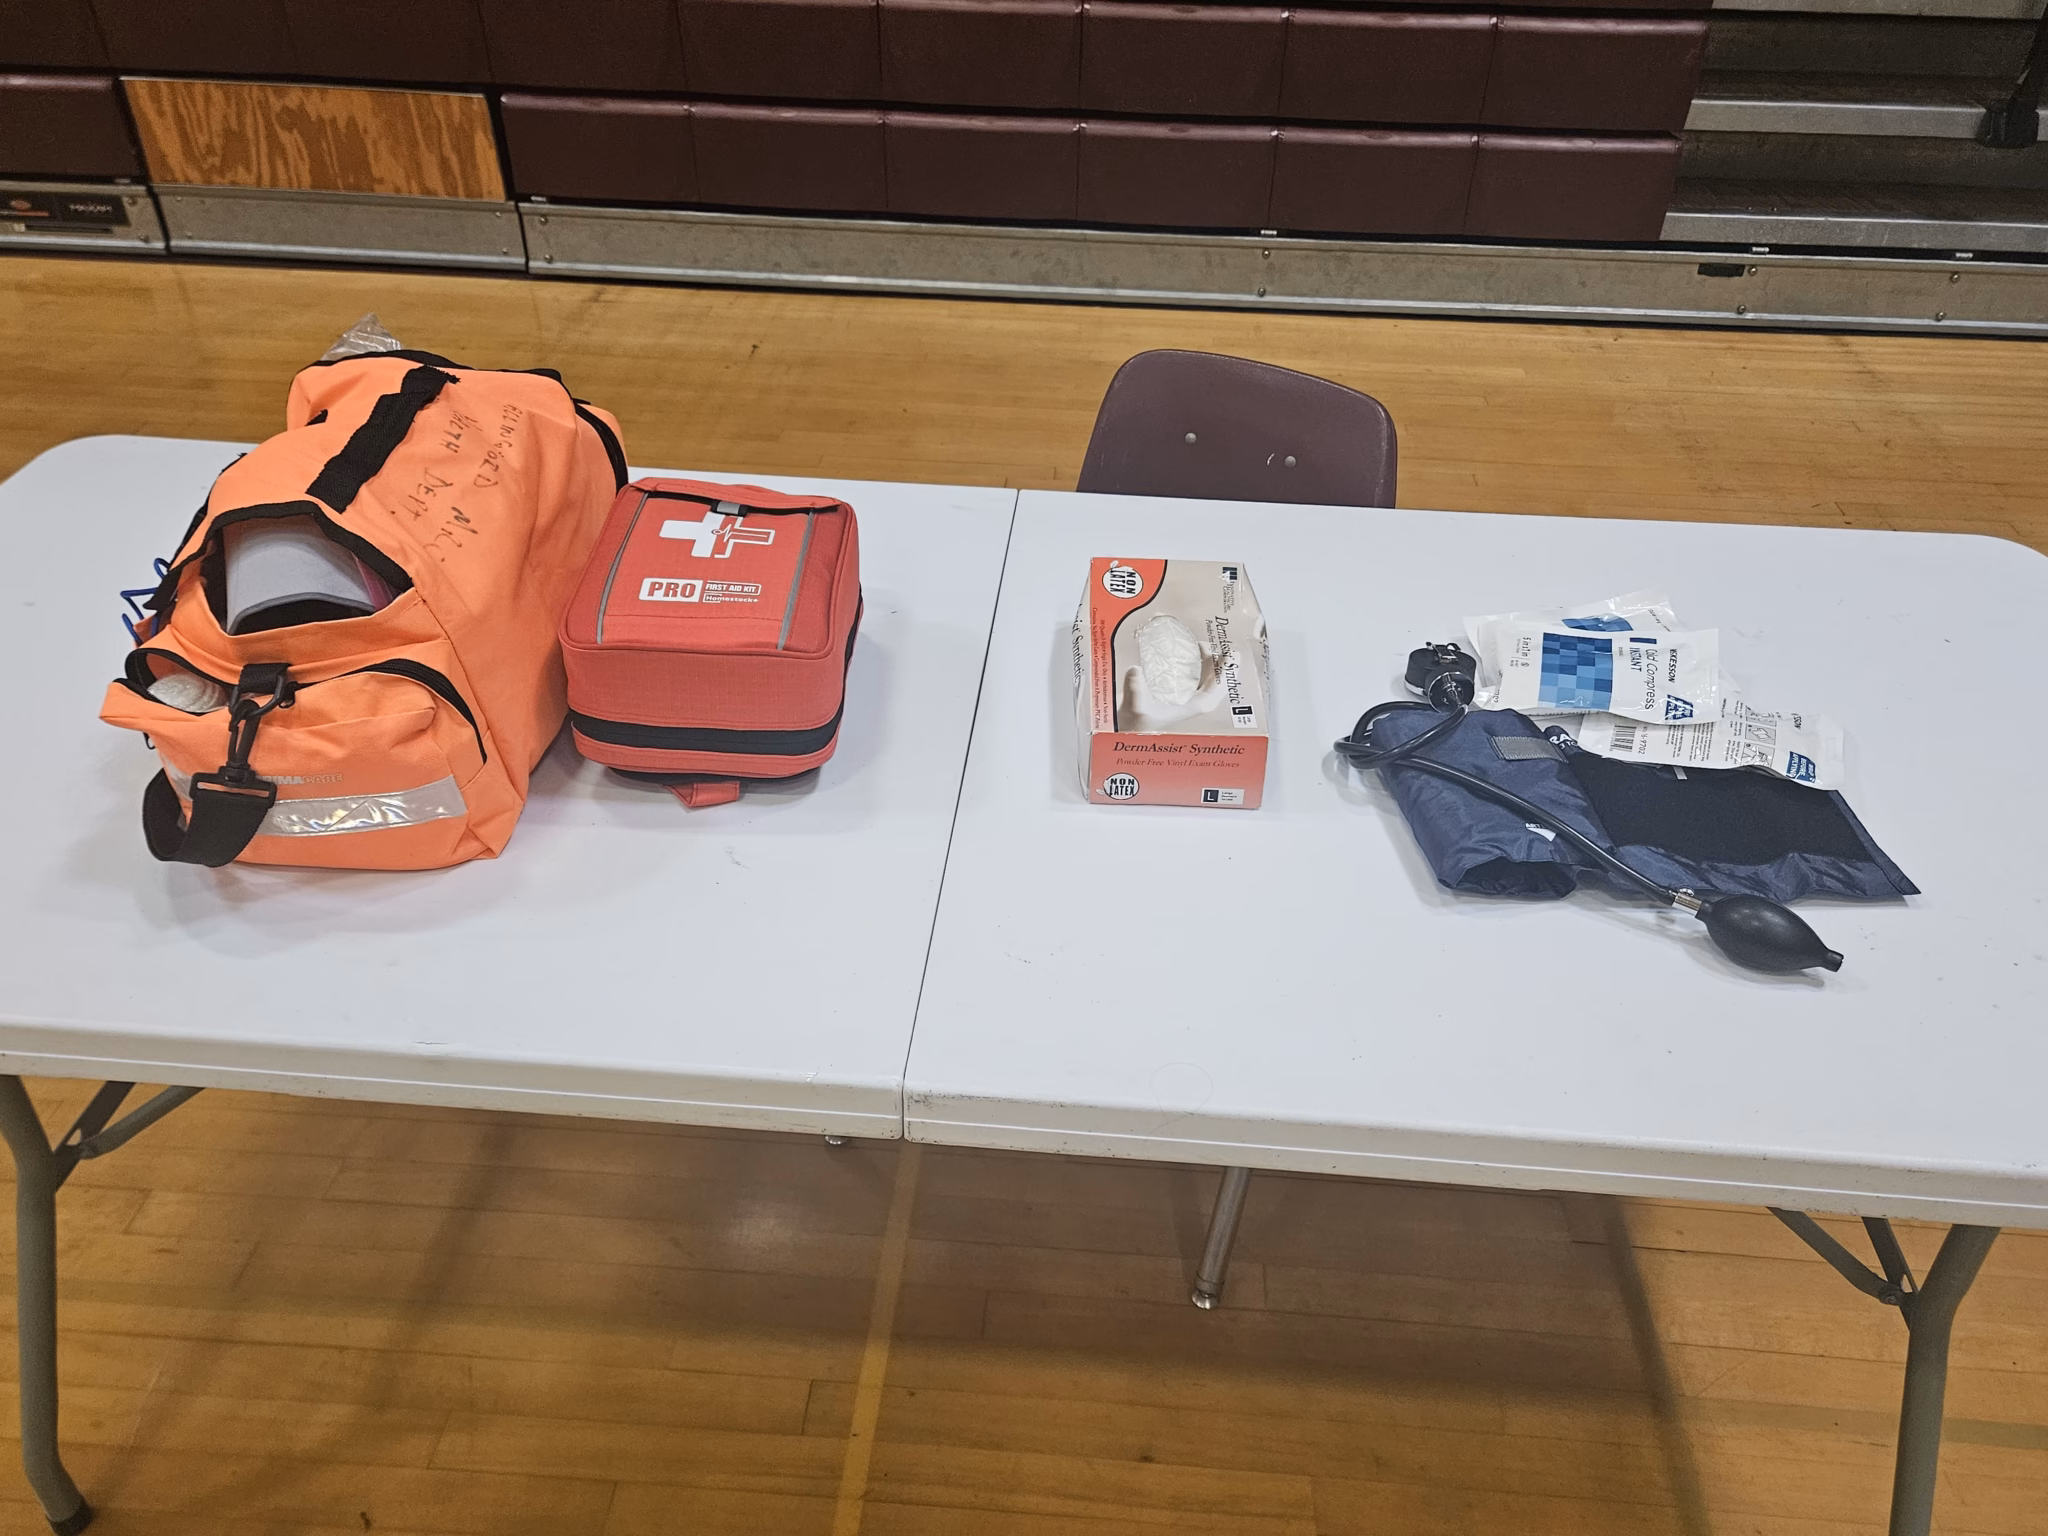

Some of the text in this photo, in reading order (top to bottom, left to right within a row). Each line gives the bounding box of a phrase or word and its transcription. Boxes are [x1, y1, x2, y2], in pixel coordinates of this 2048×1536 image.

[647, 581, 757, 598] PRO FIRST AID KIT
[1109, 569, 1126, 594] LATEX
[1126, 571, 1137, 595] NON
[1223, 662, 1243, 705] Synthetic
[1644, 662, 1658, 710] Compress
[1113, 741, 1245, 756] DermAssist Synthetic
[1188, 759, 1211, 768] Exam
[1212, 760, 1240, 768] Gloves
[1110, 777, 1135, 785] NON
[1109, 785, 1135, 796] LATEX
